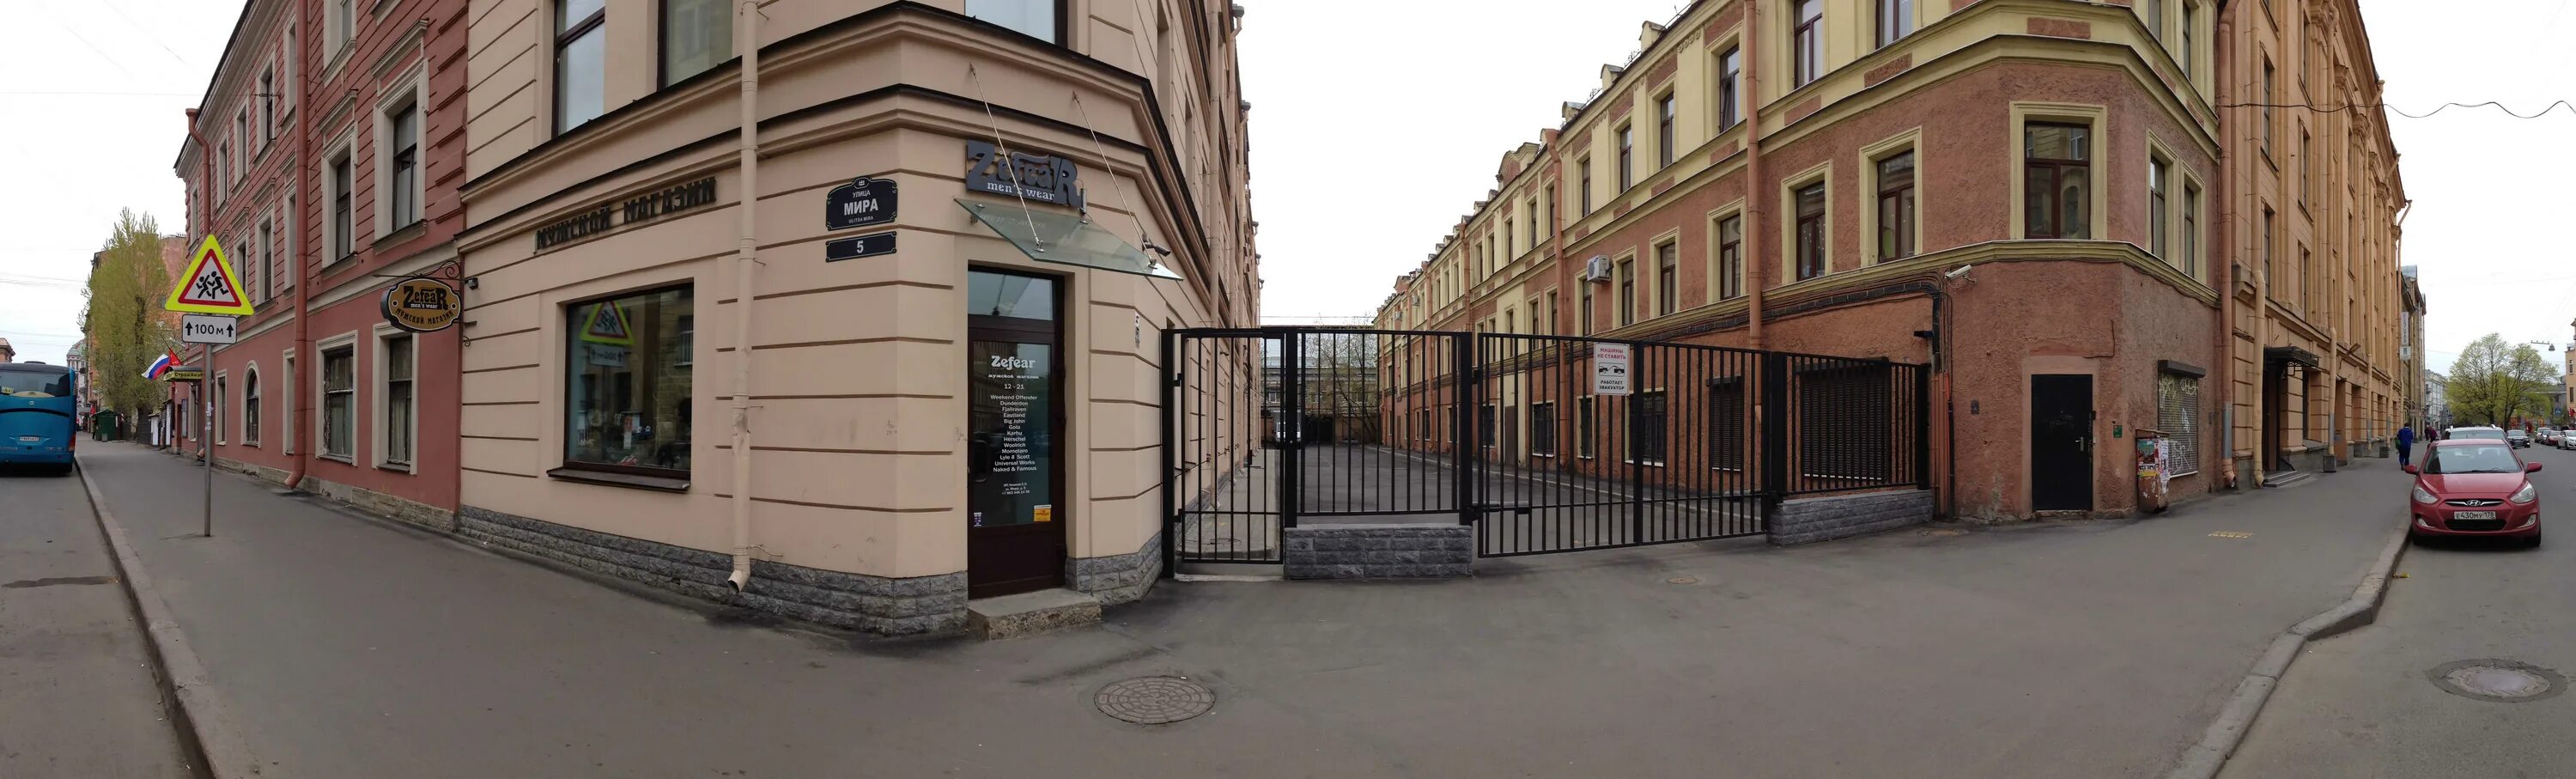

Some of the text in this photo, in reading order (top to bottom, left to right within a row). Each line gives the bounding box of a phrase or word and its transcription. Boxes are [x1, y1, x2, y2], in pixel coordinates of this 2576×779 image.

[853, 190, 871, 198] УЛИЦА
[987, 181, 1054, 201] men's wear
[536, 176, 716, 250] МУЖСКОЙ МАГАЗИН
[844, 198, 878, 216] МИРА
[857, 240, 864, 253] 5
[396, 307, 454, 325] МУЖСКОЙ МАГАЗИН
[991, 356, 1036, 370] Zefear
